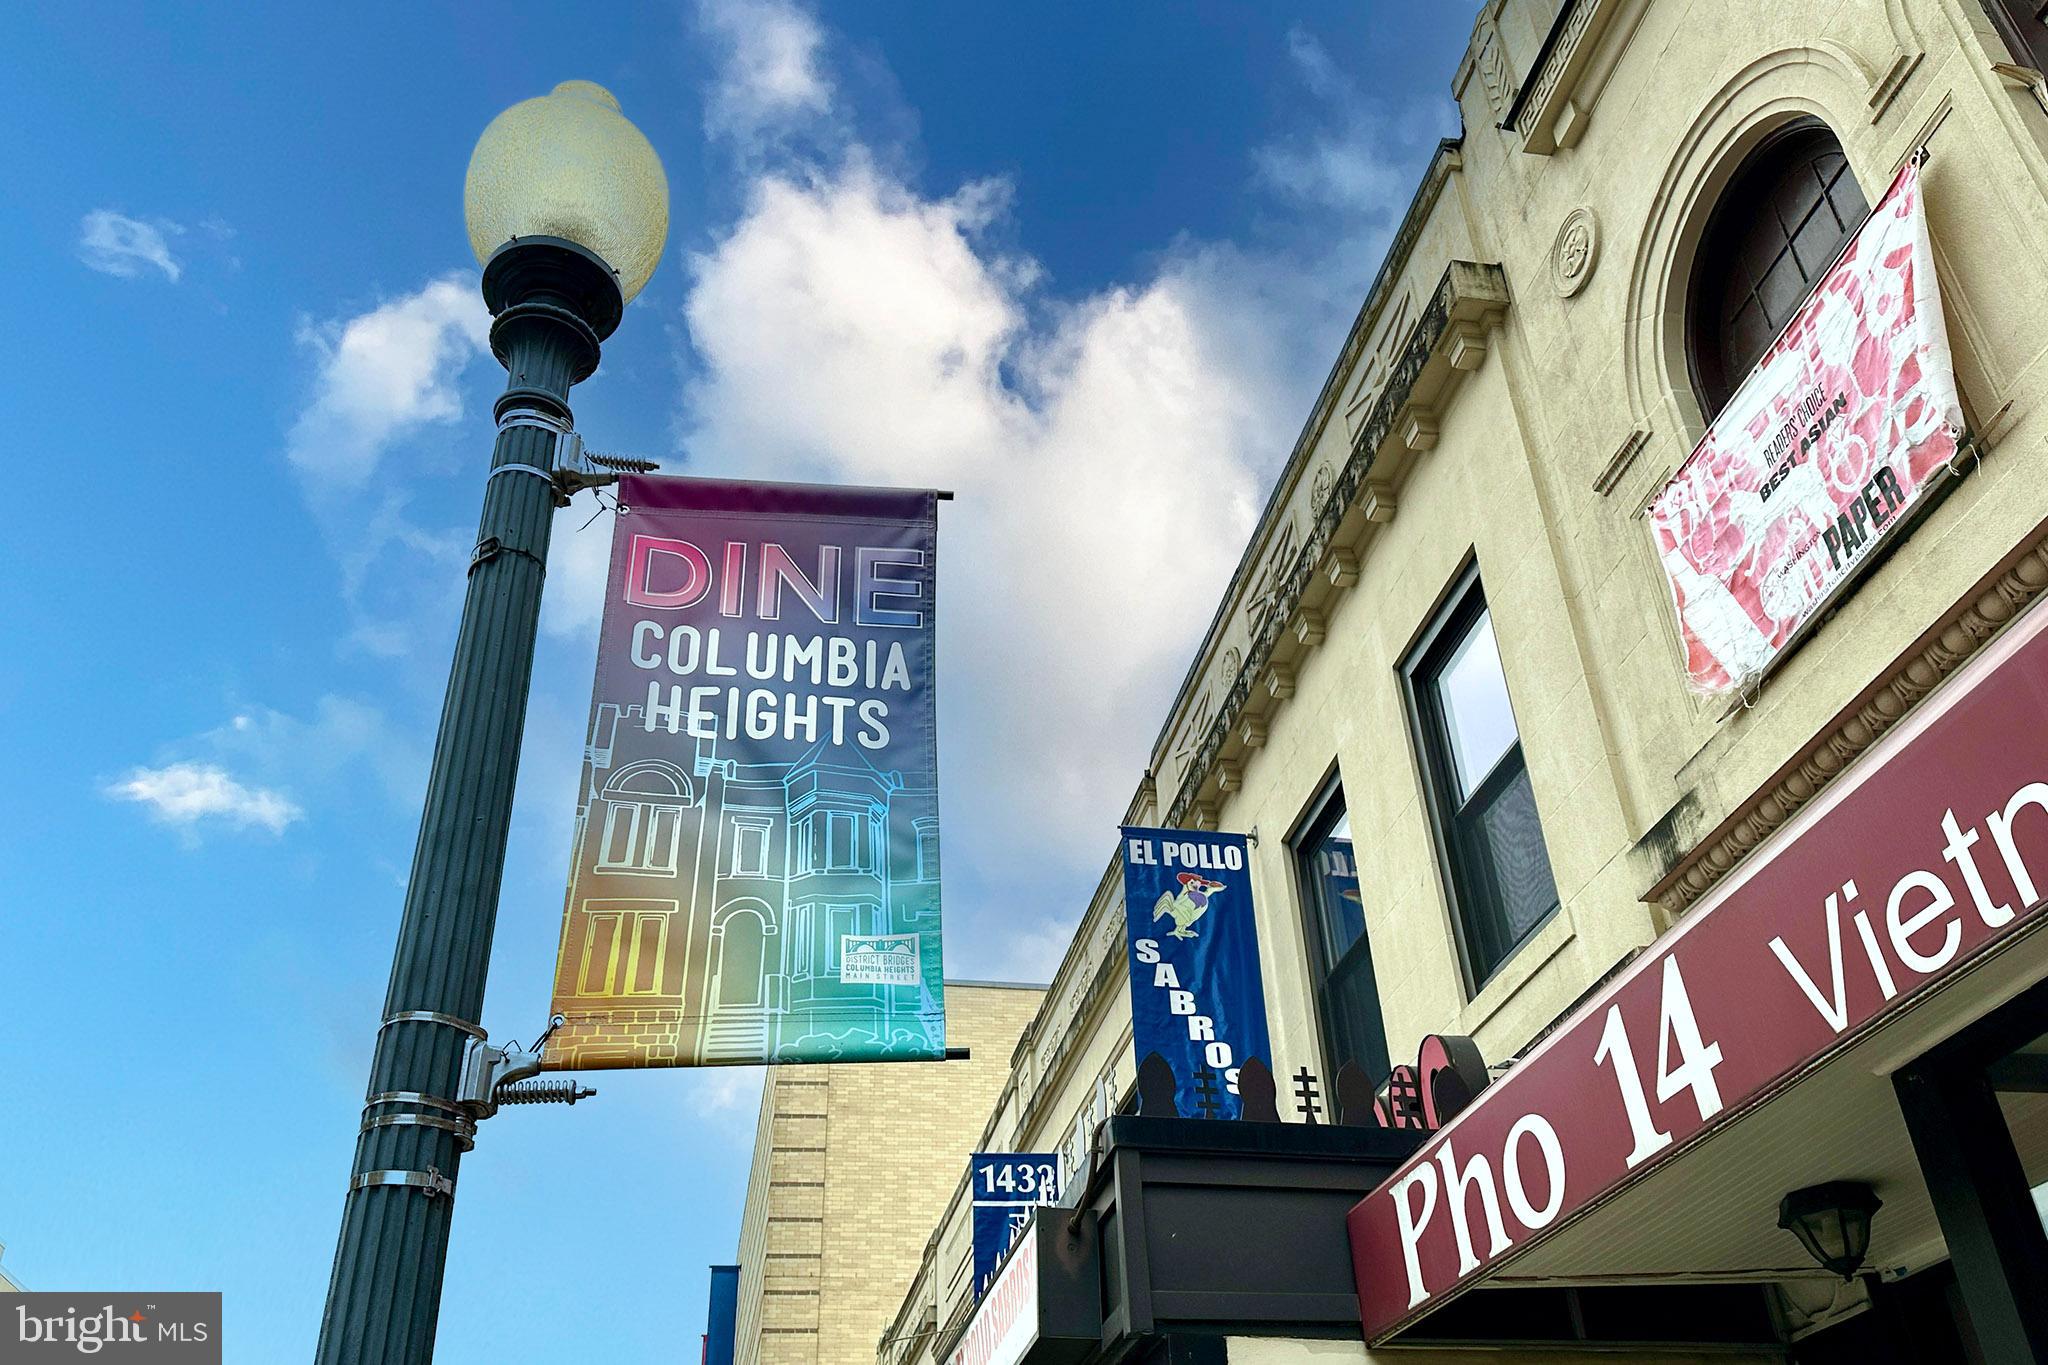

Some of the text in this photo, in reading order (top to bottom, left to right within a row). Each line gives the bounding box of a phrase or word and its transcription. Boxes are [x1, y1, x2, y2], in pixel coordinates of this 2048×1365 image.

[1760, 391, 1847, 503] BEST ASIAN
[1763, 382, 1827, 468] READERS' CHOICE
[1822, 465, 1906, 571] PAPER
[623, 534, 925, 628] DINE
[1777, 530, 1821, 579] WASHINGTON
[630, 619, 912, 691] COLUMBIA
[645, 681, 891, 750] HEIGHTS
[1128, 839, 1243, 871] EL POLLO
[846, 955, 915, 966] DISTRICT BRIDGES
[846, 964, 915, 974] COLUMBIA HEIGHTS
[1388, 1113, 1567, 1310] Pho
[1593, 952, 1724, 1170] 14
